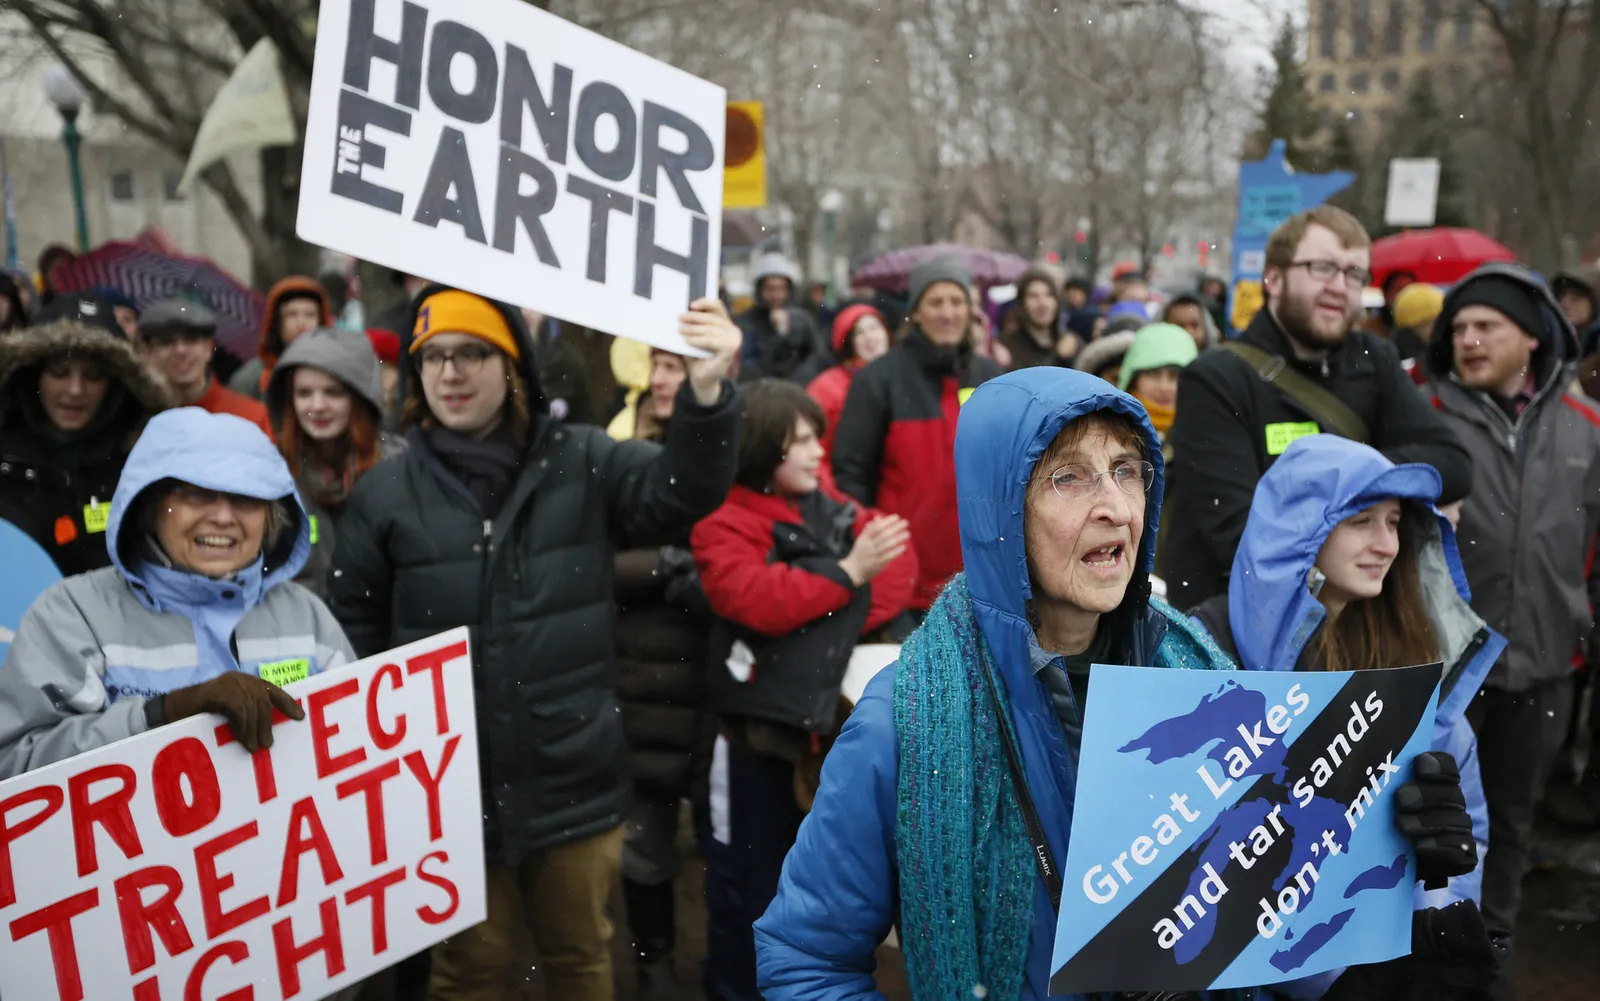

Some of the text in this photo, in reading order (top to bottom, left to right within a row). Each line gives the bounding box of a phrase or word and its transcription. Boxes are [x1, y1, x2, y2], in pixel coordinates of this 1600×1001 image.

[331, 89, 709, 310] EARTH
[337, 125, 361, 174] THE
[342, 0, 714, 215] HONOR
[0, 641, 467, 907] PROTECT
[271, 662, 303, 676] MORE
[10, 735, 461, 1001] TREATY
[1036, 844, 1052, 877] LUMIX
[1082, 683, 1310, 904] Great Lakes
[1151, 690, 1384, 949] and tar sands
[1256, 750, 1401, 940] don't mix
